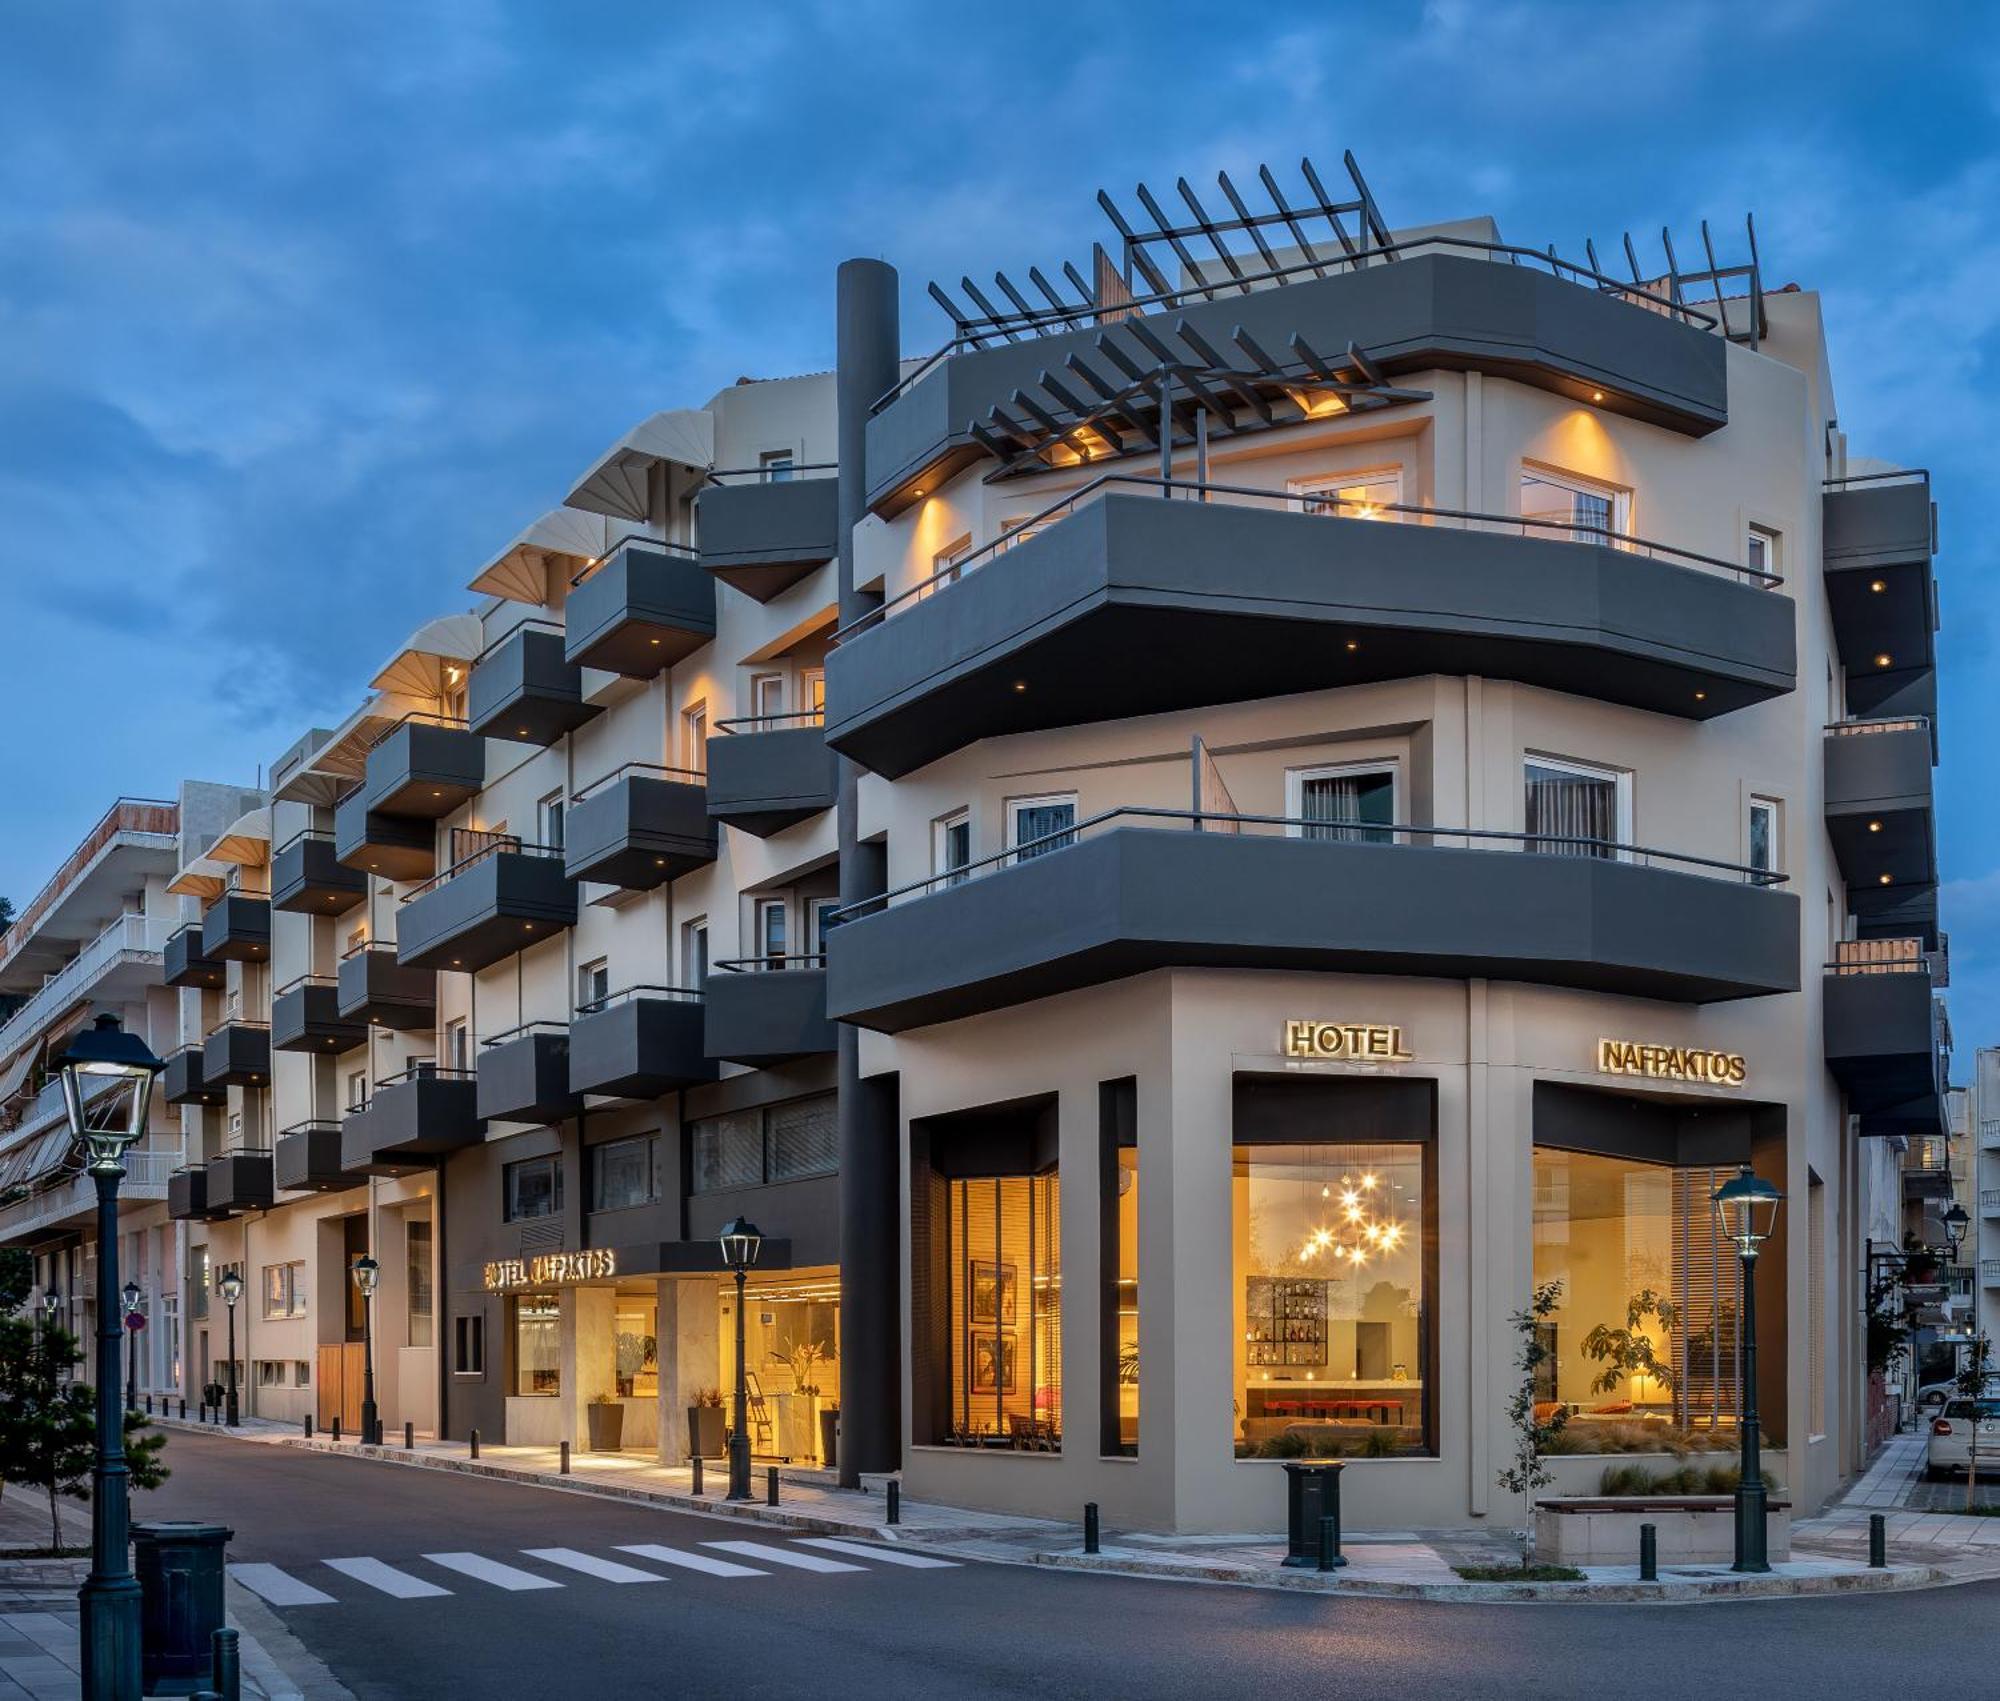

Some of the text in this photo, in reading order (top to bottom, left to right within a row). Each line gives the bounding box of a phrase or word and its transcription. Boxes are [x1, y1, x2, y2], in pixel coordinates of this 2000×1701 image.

[1289, 1023, 1413, 1058] HOTEL
[1602, 1040, 1746, 1082] NAFPAKTOS
[485, 1260, 528, 1289] HOTEL
